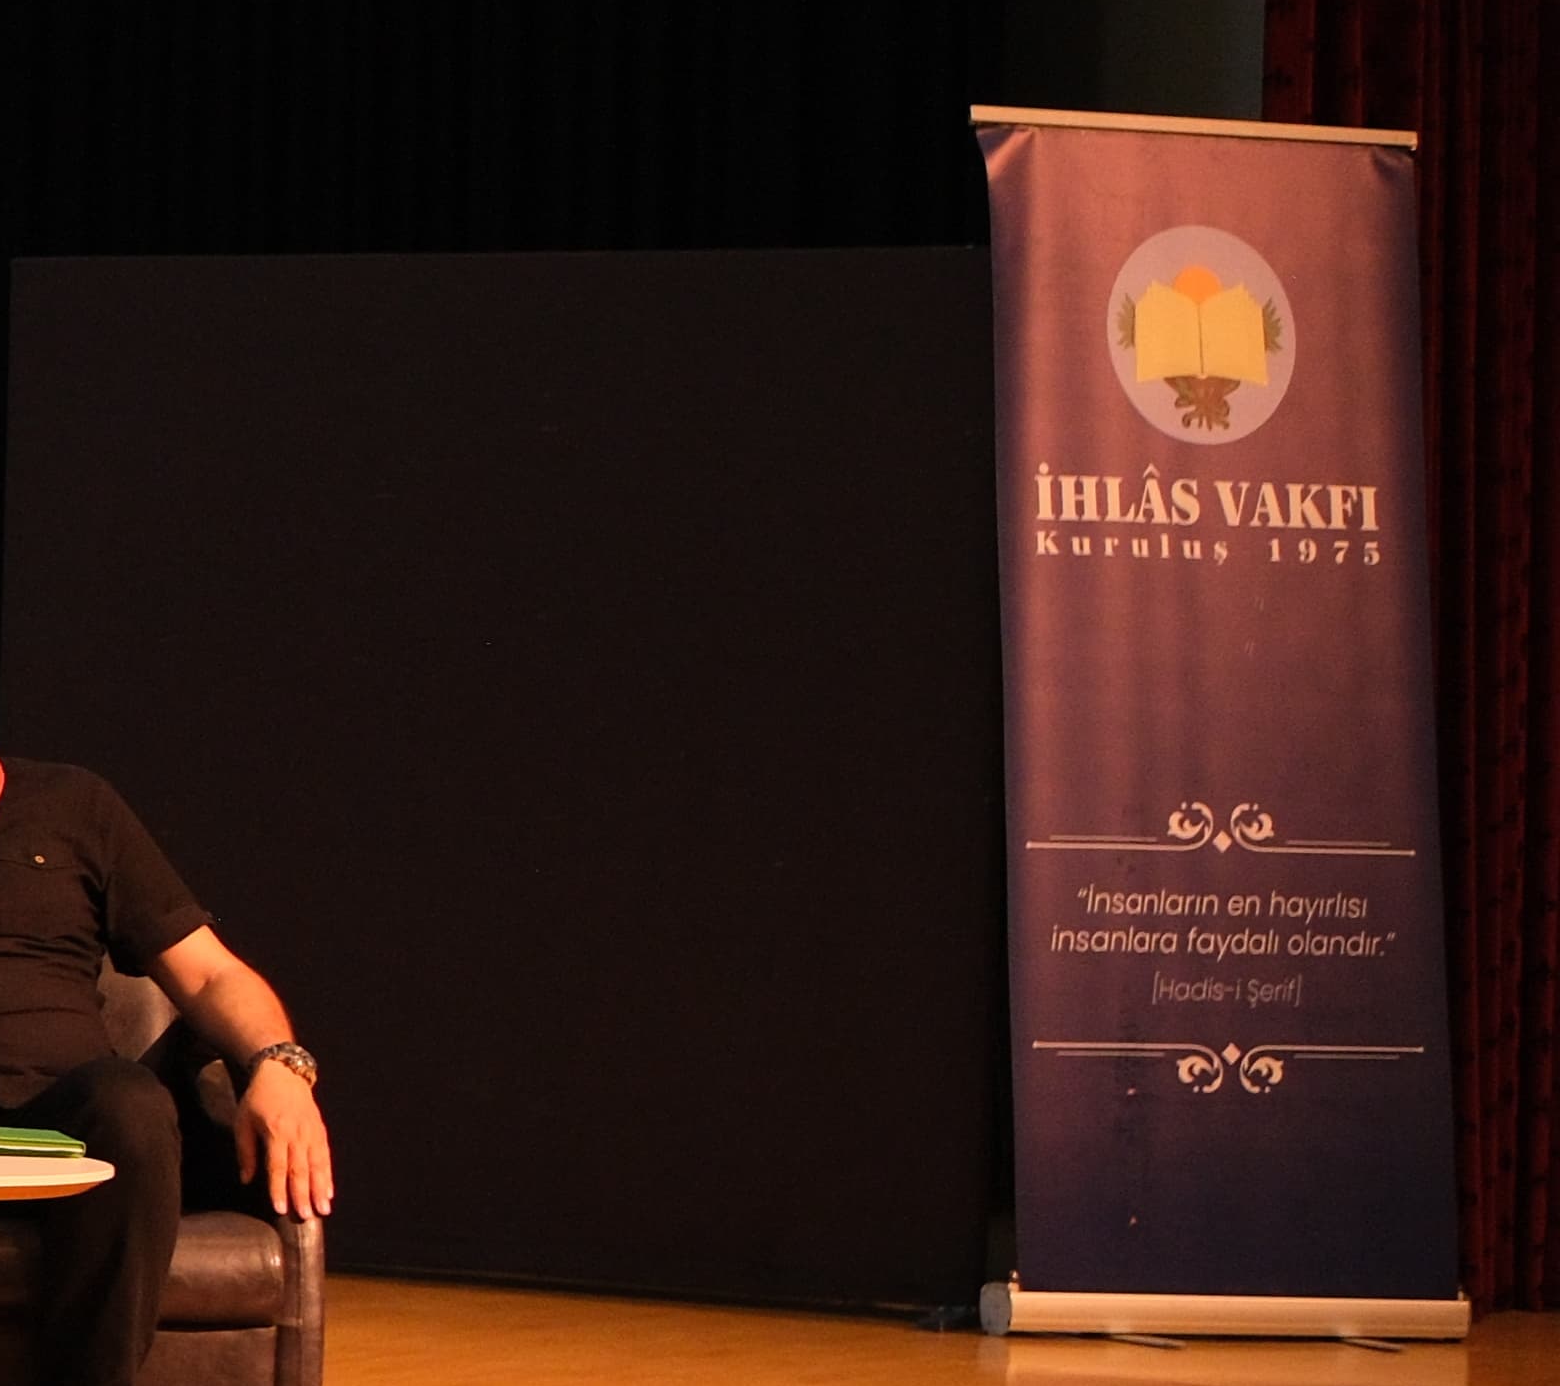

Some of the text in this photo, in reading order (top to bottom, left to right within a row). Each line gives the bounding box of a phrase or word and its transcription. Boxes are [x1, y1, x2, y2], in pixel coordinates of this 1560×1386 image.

[1034, 462, 1380, 532] İHLÂS VAKFI
[1035, 530, 1380, 565] Kuruluş 1975
[1227, 894, 1261, 916] en
[1269, 890, 1368, 924] hayırlısı
[1050, 924, 1178, 954] insanlara
[1186, 926, 1279, 962] faydalı
